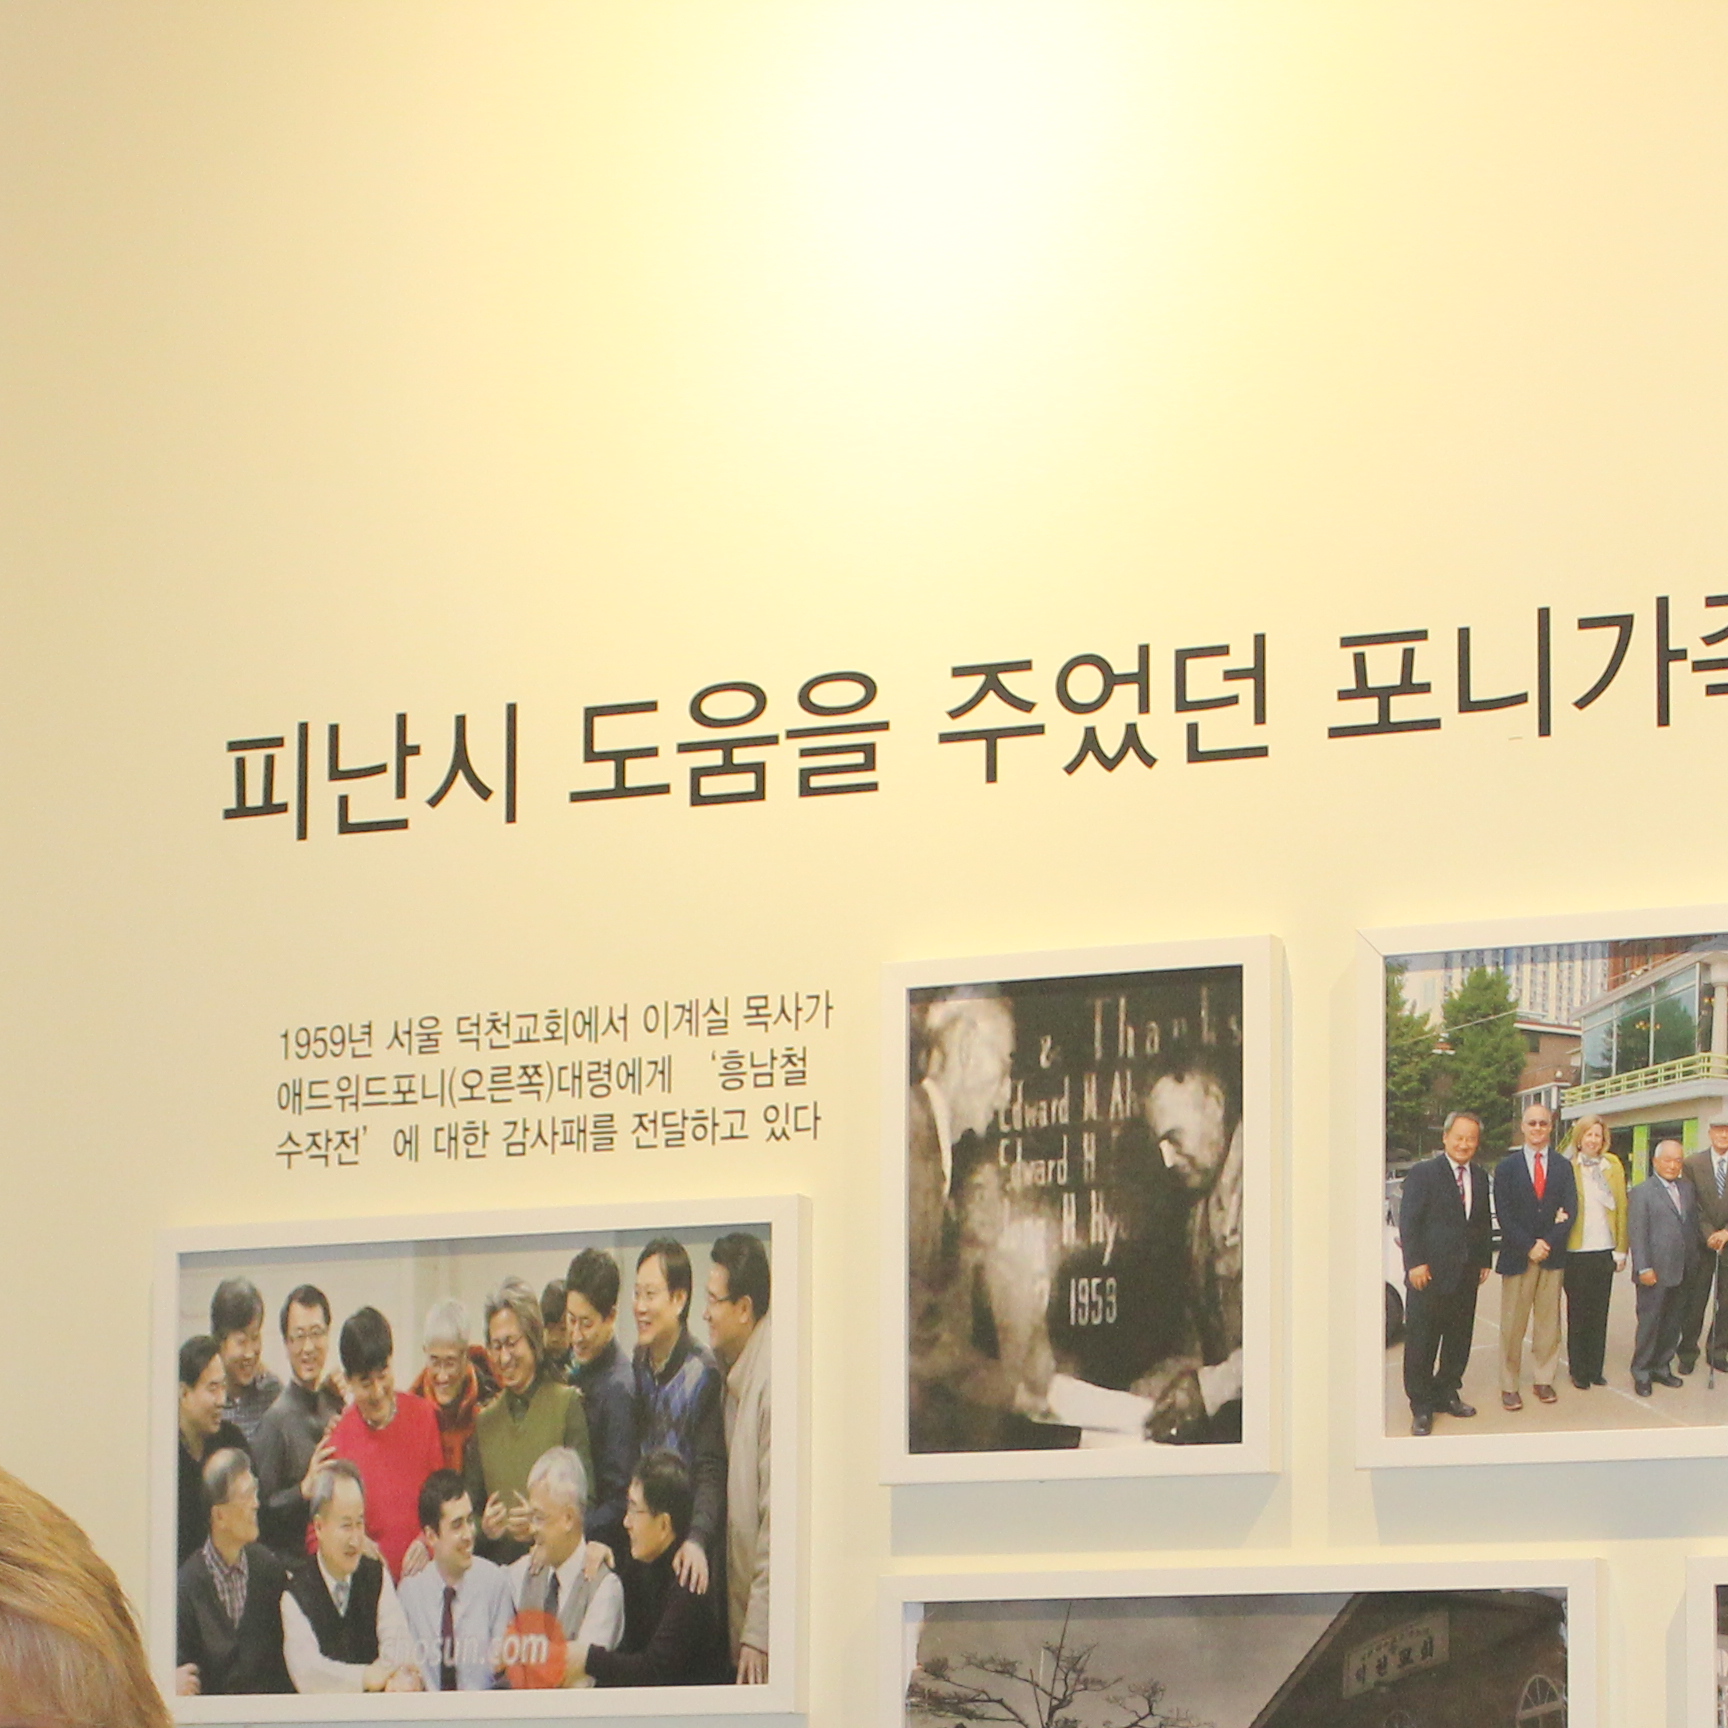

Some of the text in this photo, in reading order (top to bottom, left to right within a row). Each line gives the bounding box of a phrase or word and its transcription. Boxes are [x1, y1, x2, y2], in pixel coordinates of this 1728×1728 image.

[221, 701, 518, 842] 피난시
[567, 670, 891, 807] 도움을
[937, 632, 1269, 783] 주었던
[279, 989, 834, 1060] 1959년 서울 덕천교회에서 이계실 목사가
[276, 1054, 672, 1116] 애드워드포니(오른쪽)대령에게
[393, 1124, 419, 1163] 에
[434, 1120, 490, 1160] 대한
[502, 1113, 618, 1157] 감사패를
[631, 1106, 749, 1150] 전달하고
[763, 1100, 821, 1142] 있다
